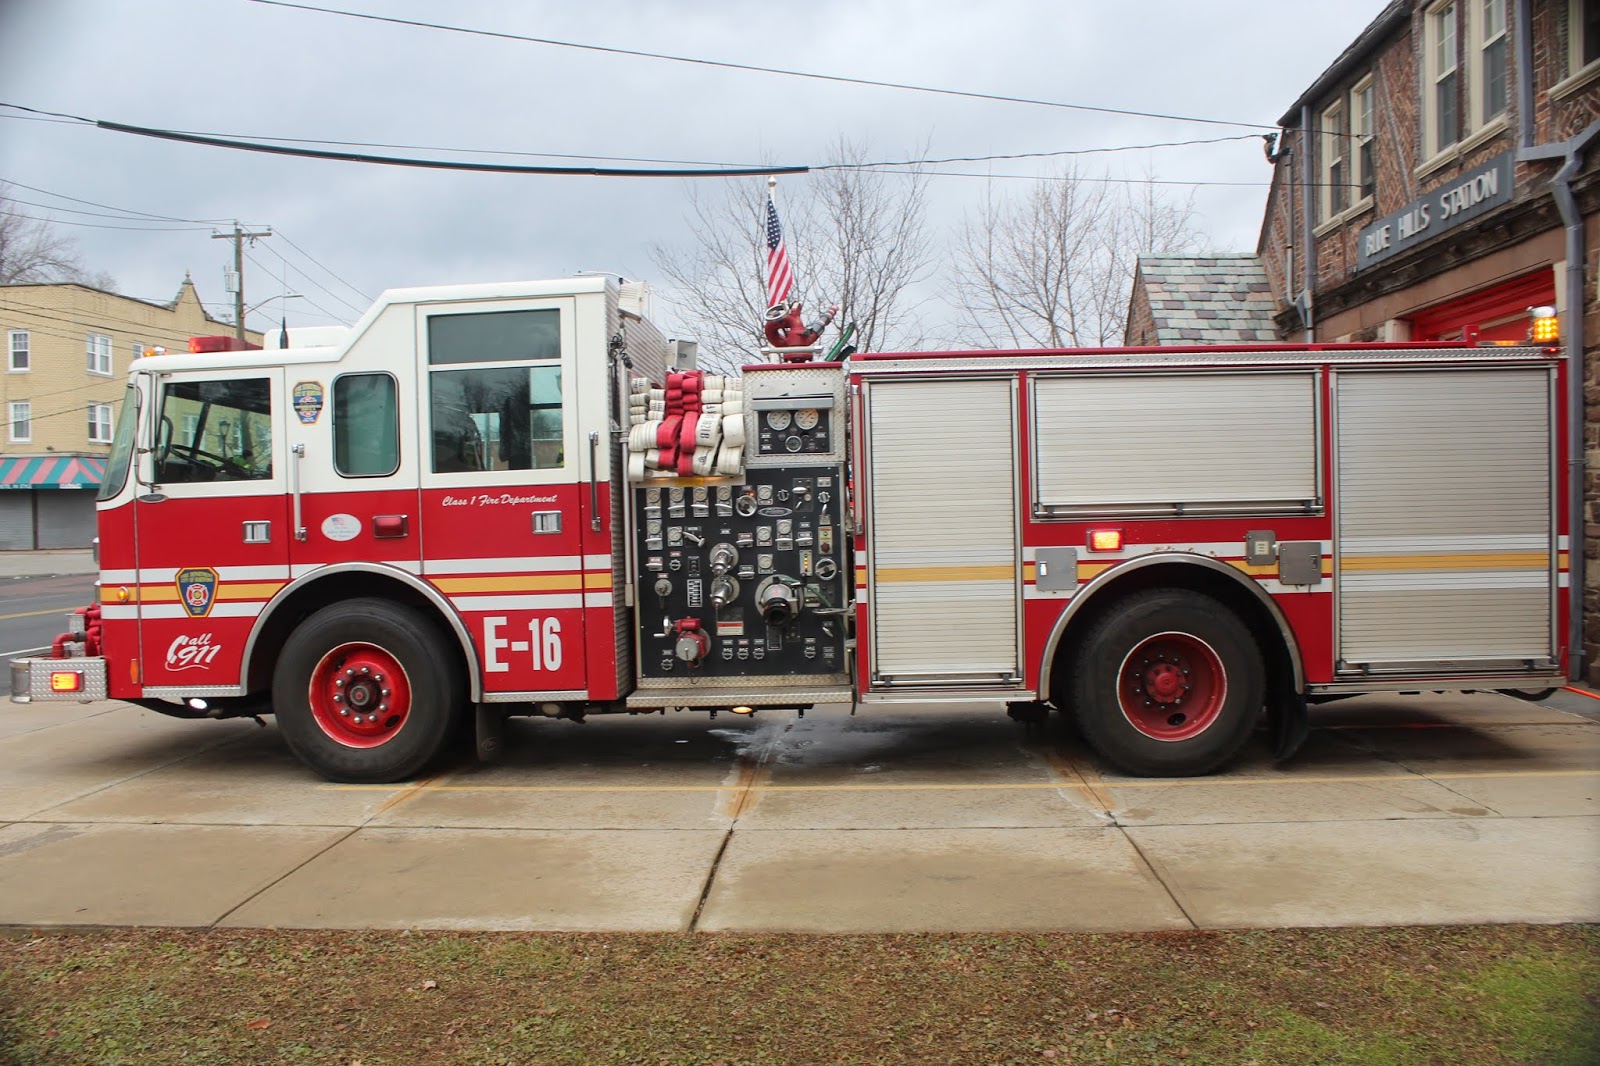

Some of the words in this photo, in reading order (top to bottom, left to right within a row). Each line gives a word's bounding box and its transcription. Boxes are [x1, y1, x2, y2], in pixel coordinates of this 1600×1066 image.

[1365, 224, 1391, 257] BLUE
[1397, 203, 1430, 241] HILLS
[1440, 167, 1498, 220] STATION
[442, 495, 468, 507] Class
[470, 496, 477, 506] 1
[478, 494, 500, 507] Fire
[500, 493, 558, 506] Department
[177, 644, 222, 666] 911
[483, 616, 562, 673] E-16
